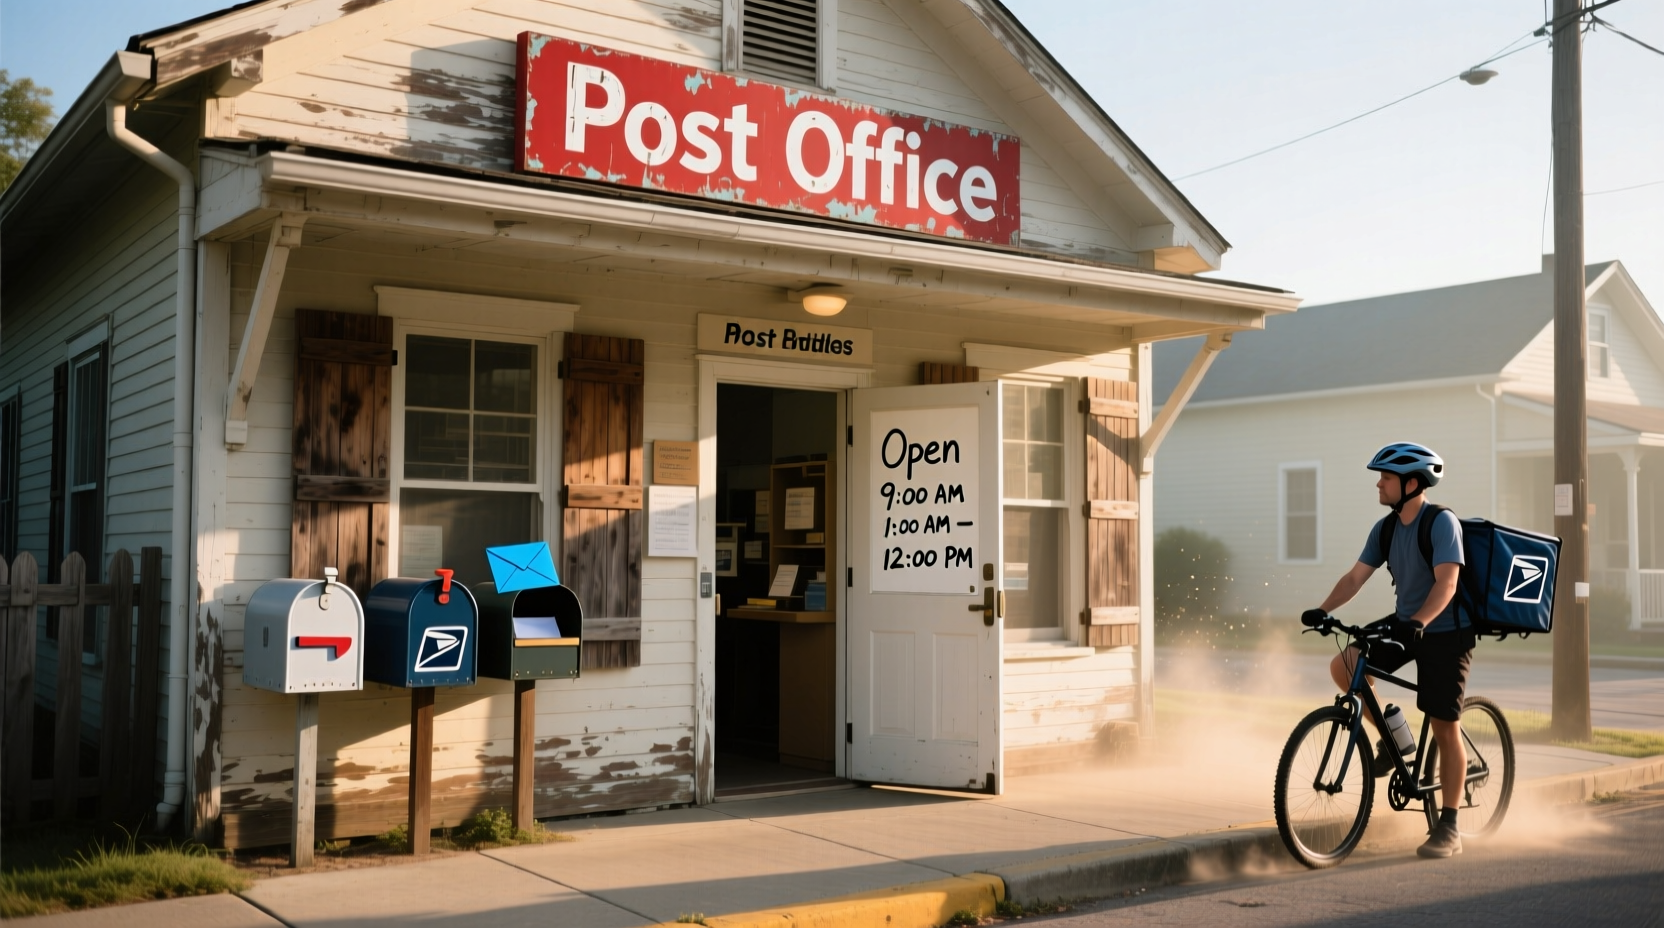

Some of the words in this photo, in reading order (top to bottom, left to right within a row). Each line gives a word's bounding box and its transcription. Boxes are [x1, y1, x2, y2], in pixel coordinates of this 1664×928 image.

[564, 61, 759, 182] Post
[785, 110, 998, 222] Office
[723, 322, 777, 349] Post
[881, 427, 960, 481] Open
[880, 481, 929, 511] 9:00
[934, 483, 965, 505] AM
[884, 516, 920, 539] 1:00
[923, 514, 951, 534] AM
[883, 546, 938, 571] 12:00
[944, 545, 973, 569] PM
